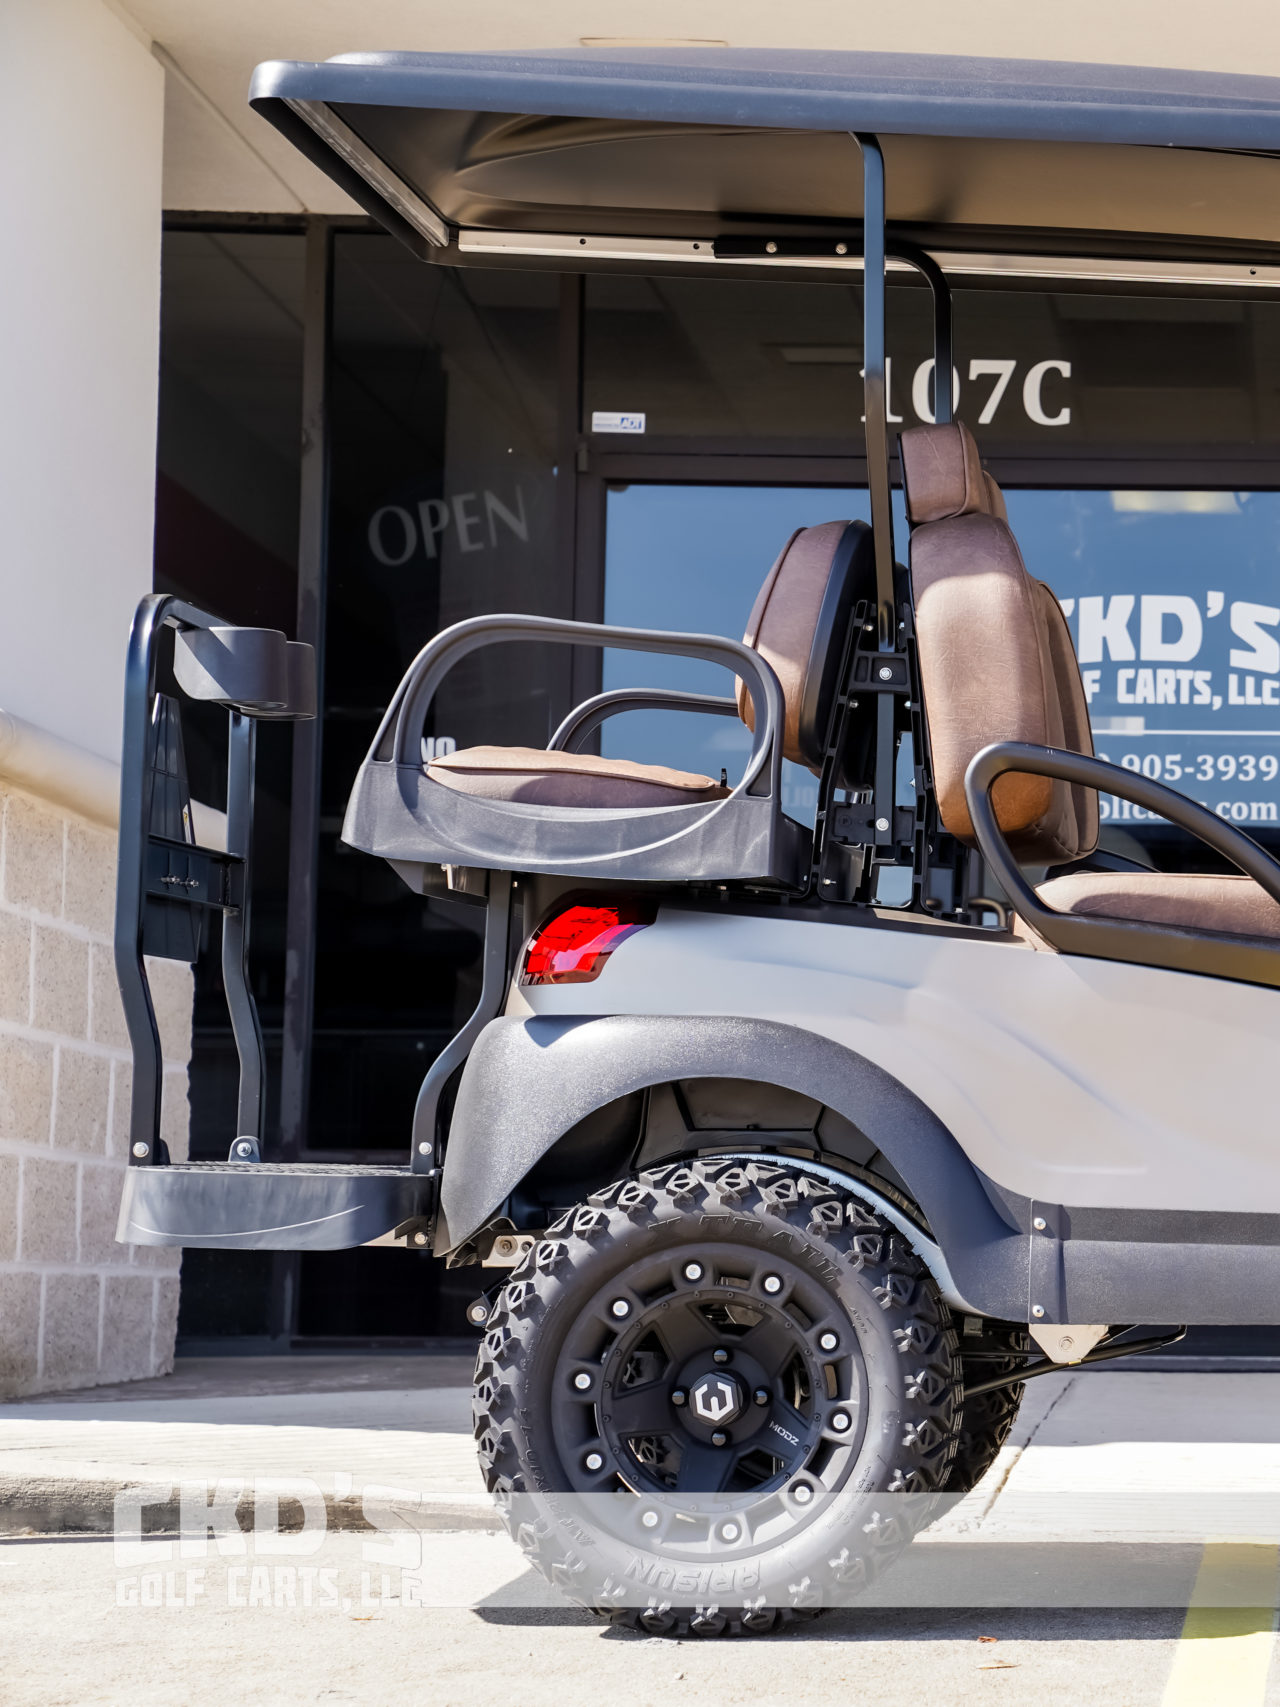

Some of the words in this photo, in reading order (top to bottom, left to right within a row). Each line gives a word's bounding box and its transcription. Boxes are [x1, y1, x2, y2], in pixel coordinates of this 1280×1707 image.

[368, 484, 529, 566] OPEN
[1228, 673, 1280, 705] LLC
[1120, 753, 1279, 781] 905-3939
[769, 1420, 799, 1446] MODZ
